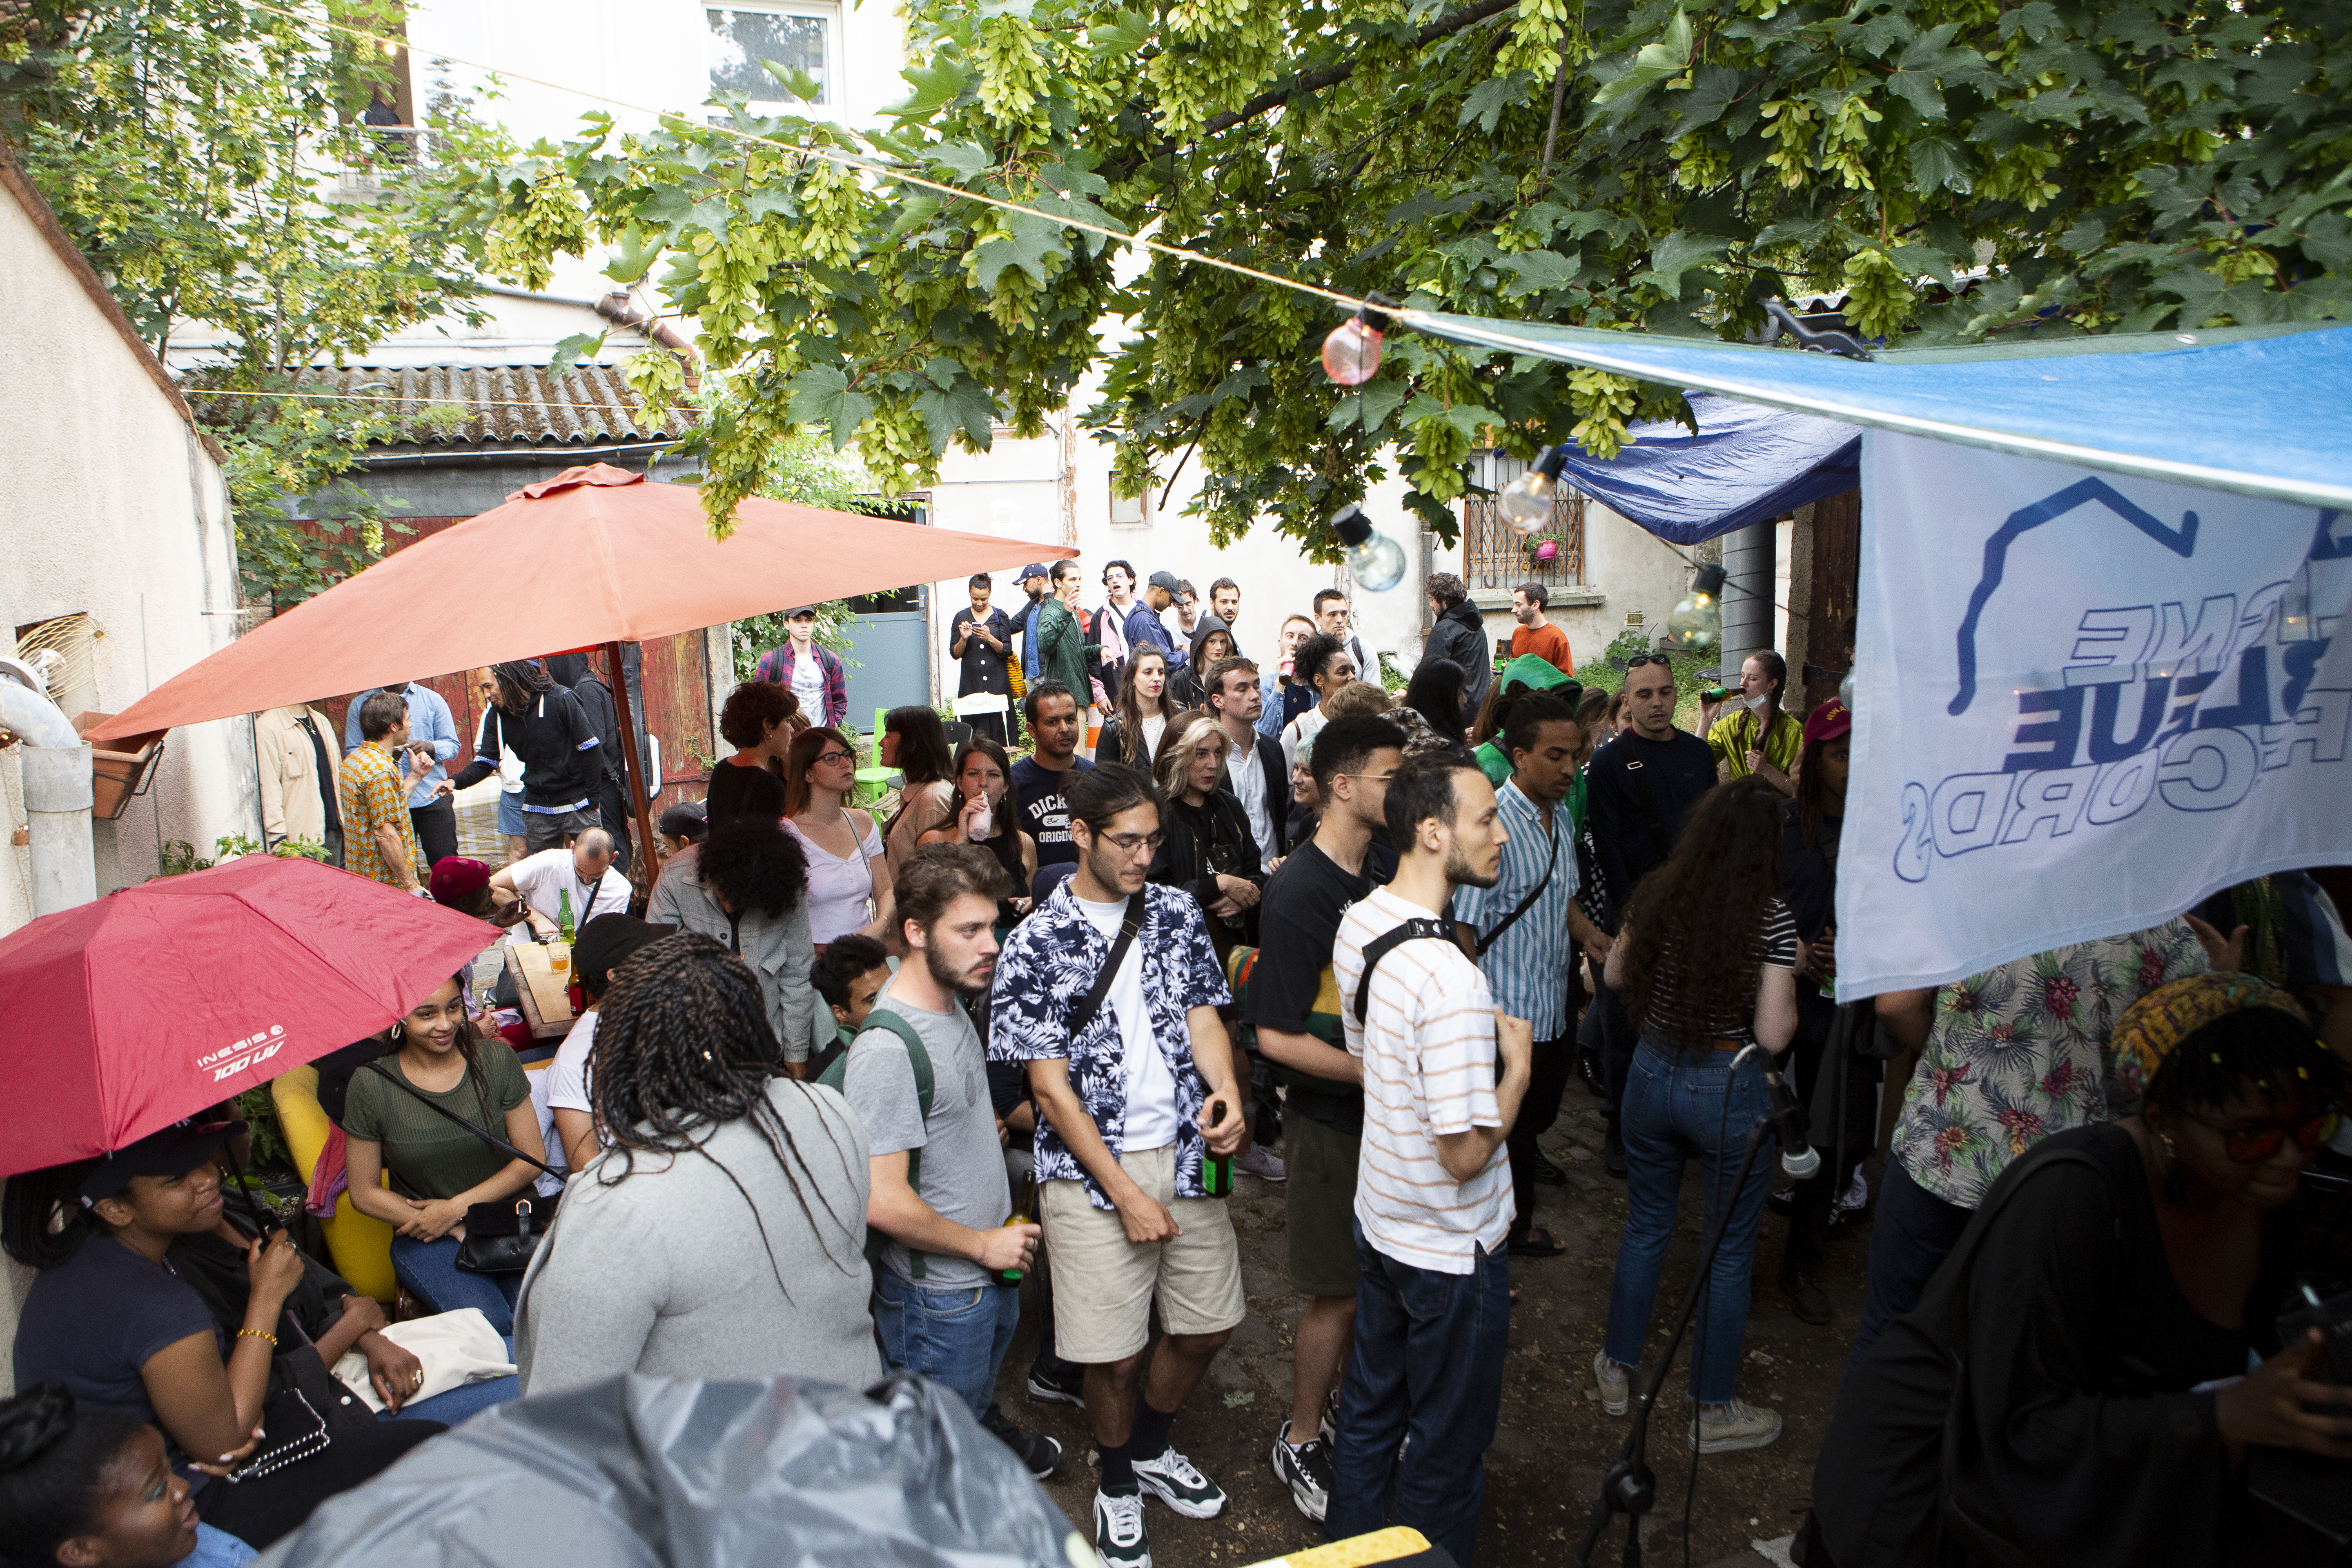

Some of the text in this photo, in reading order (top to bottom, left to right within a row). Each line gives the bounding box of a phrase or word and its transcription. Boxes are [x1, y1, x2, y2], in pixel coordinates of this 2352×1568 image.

[968, 699, 992, 707] Frutti
[1826, 705, 1847, 720] RWA
[1028, 794, 1069, 820] DICK
[1039, 830, 1075, 843] ORIGIN
[197, 1031, 267, 1067] INESIS
[214, 1040, 285, 1082] 100 UV
